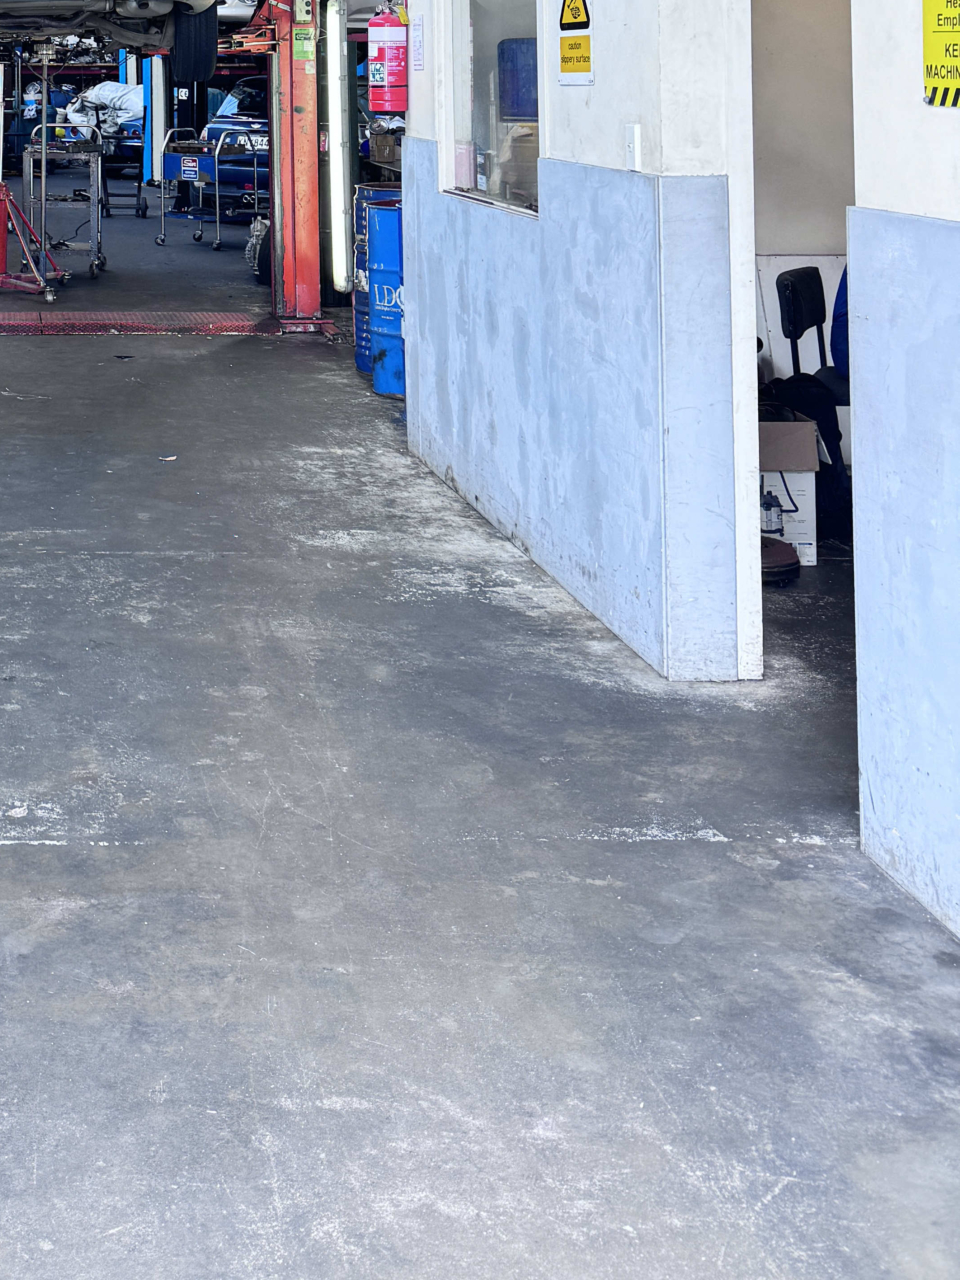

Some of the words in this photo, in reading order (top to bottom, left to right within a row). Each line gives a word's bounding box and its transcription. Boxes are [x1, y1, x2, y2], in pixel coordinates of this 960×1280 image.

[568, 40, 582, 51] caution
[561, 54, 575, 66] slippery
[575, 53, 590, 64] surface
